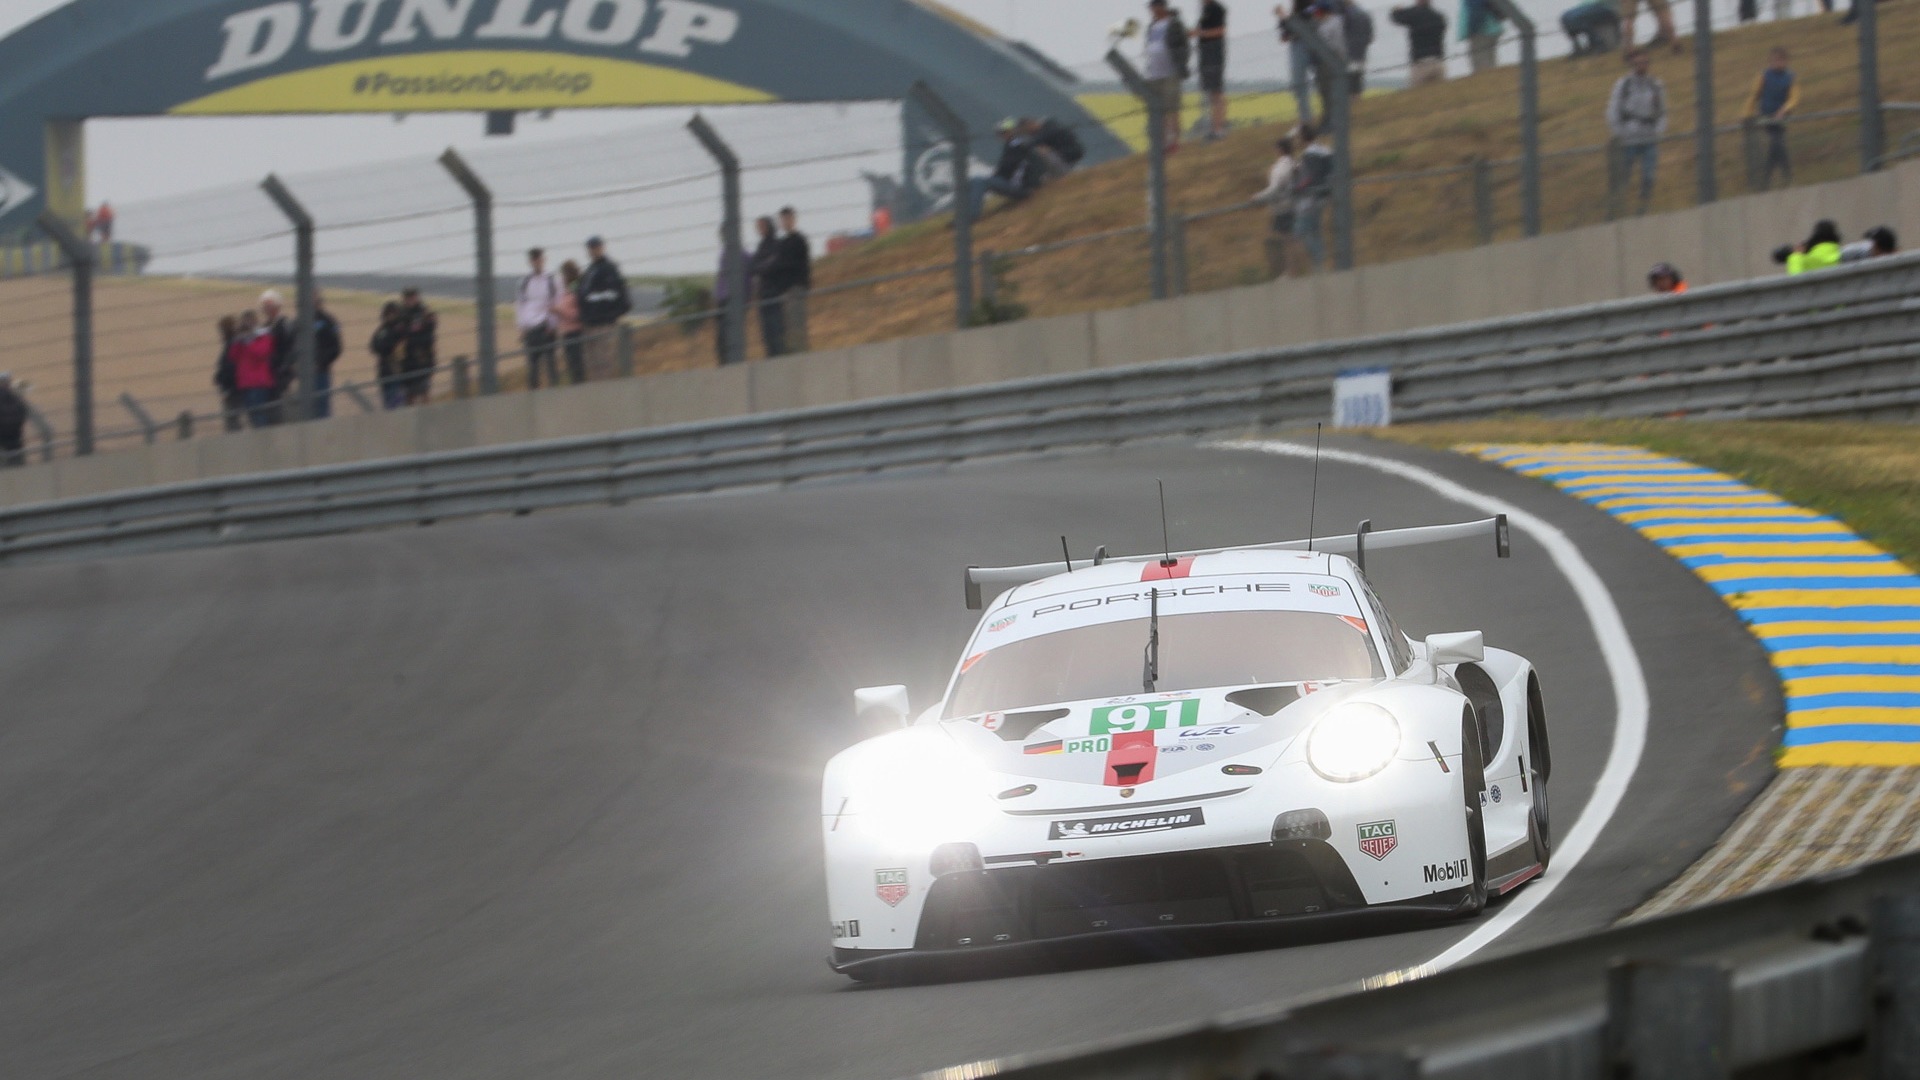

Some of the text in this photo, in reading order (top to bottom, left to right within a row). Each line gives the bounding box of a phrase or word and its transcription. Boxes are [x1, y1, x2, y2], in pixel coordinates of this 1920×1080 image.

[205, 0, 739, 80] DUNLOP
[353, 68, 592, 95] #PassionDunlop
[1033, 582, 1291, 618] PORSCHE
[1107, 702, 1182, 734] 91
[1068, 738, 1109, 753] PRO
[1091, 814, 1191, 832] MICHELIN
[1360, 824, 1392, 837] TAG
[1362, 837, 1395, 856] HEUER
[877, 872, 905, 883] TAG
[1423, 860, 1460, 883] Mobil
